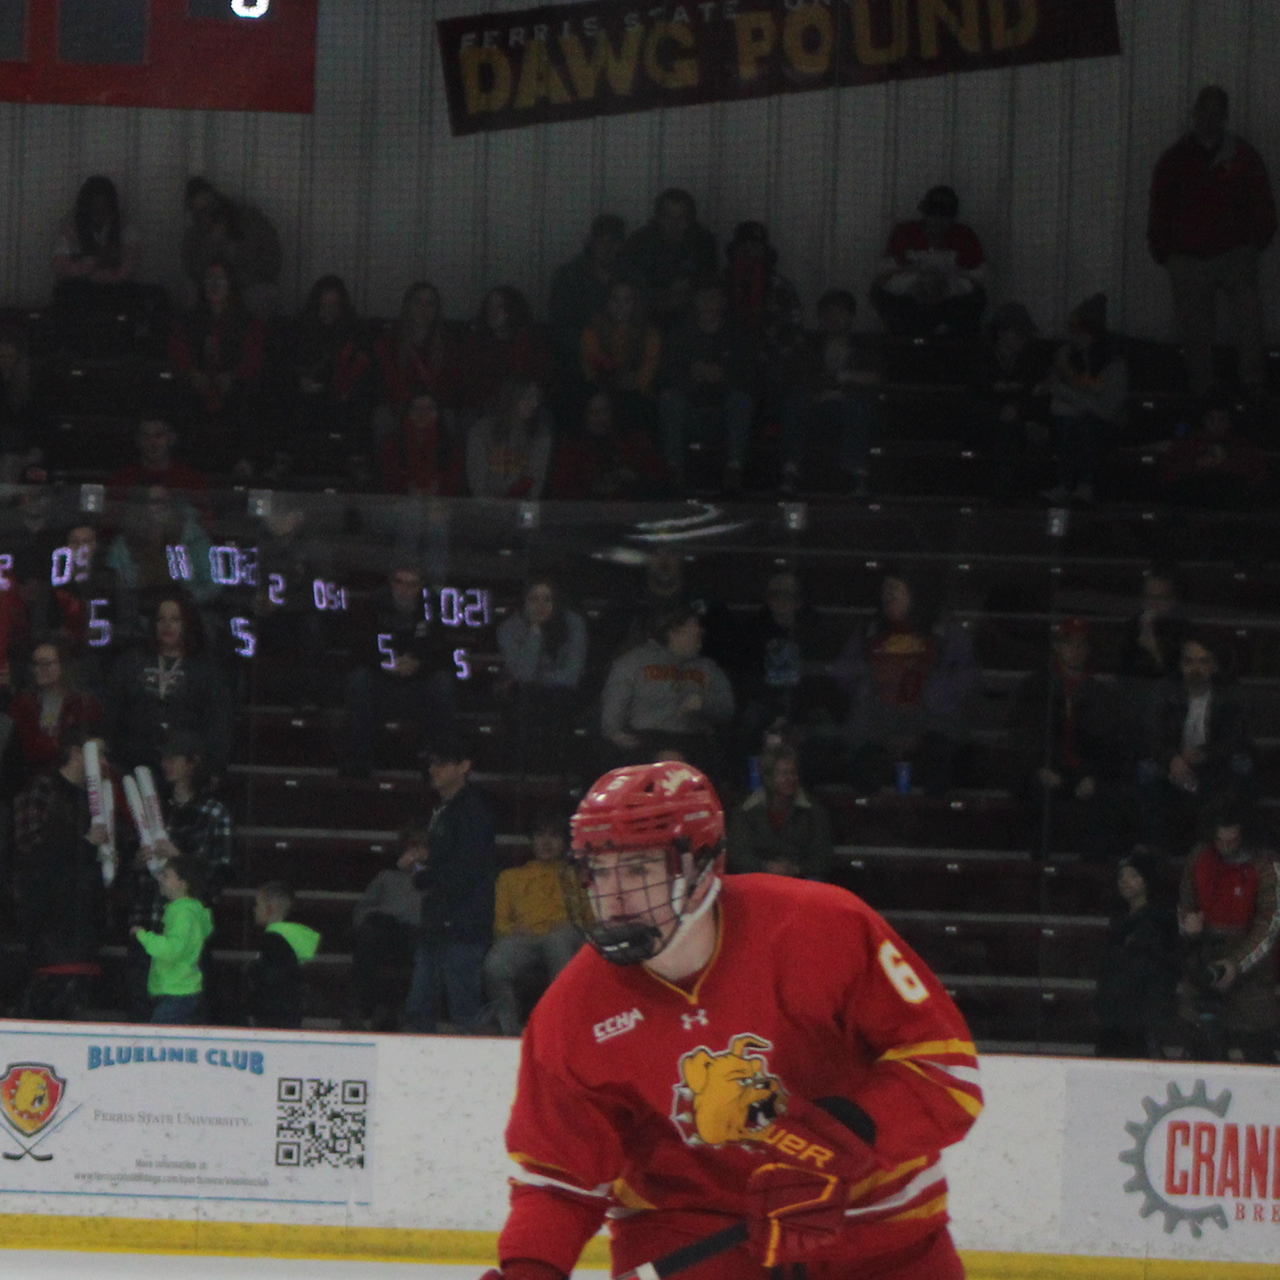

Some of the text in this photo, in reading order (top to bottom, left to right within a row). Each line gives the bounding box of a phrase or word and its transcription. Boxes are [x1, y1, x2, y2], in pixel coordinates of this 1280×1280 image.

[459, 0, 1039, 115] DAWG POUND
[878, 938, 930, 1004] 6
[593, 1007, 645, 1040] CCHA
[88, 1045, 265, 1076] BLUELINE CLUB
